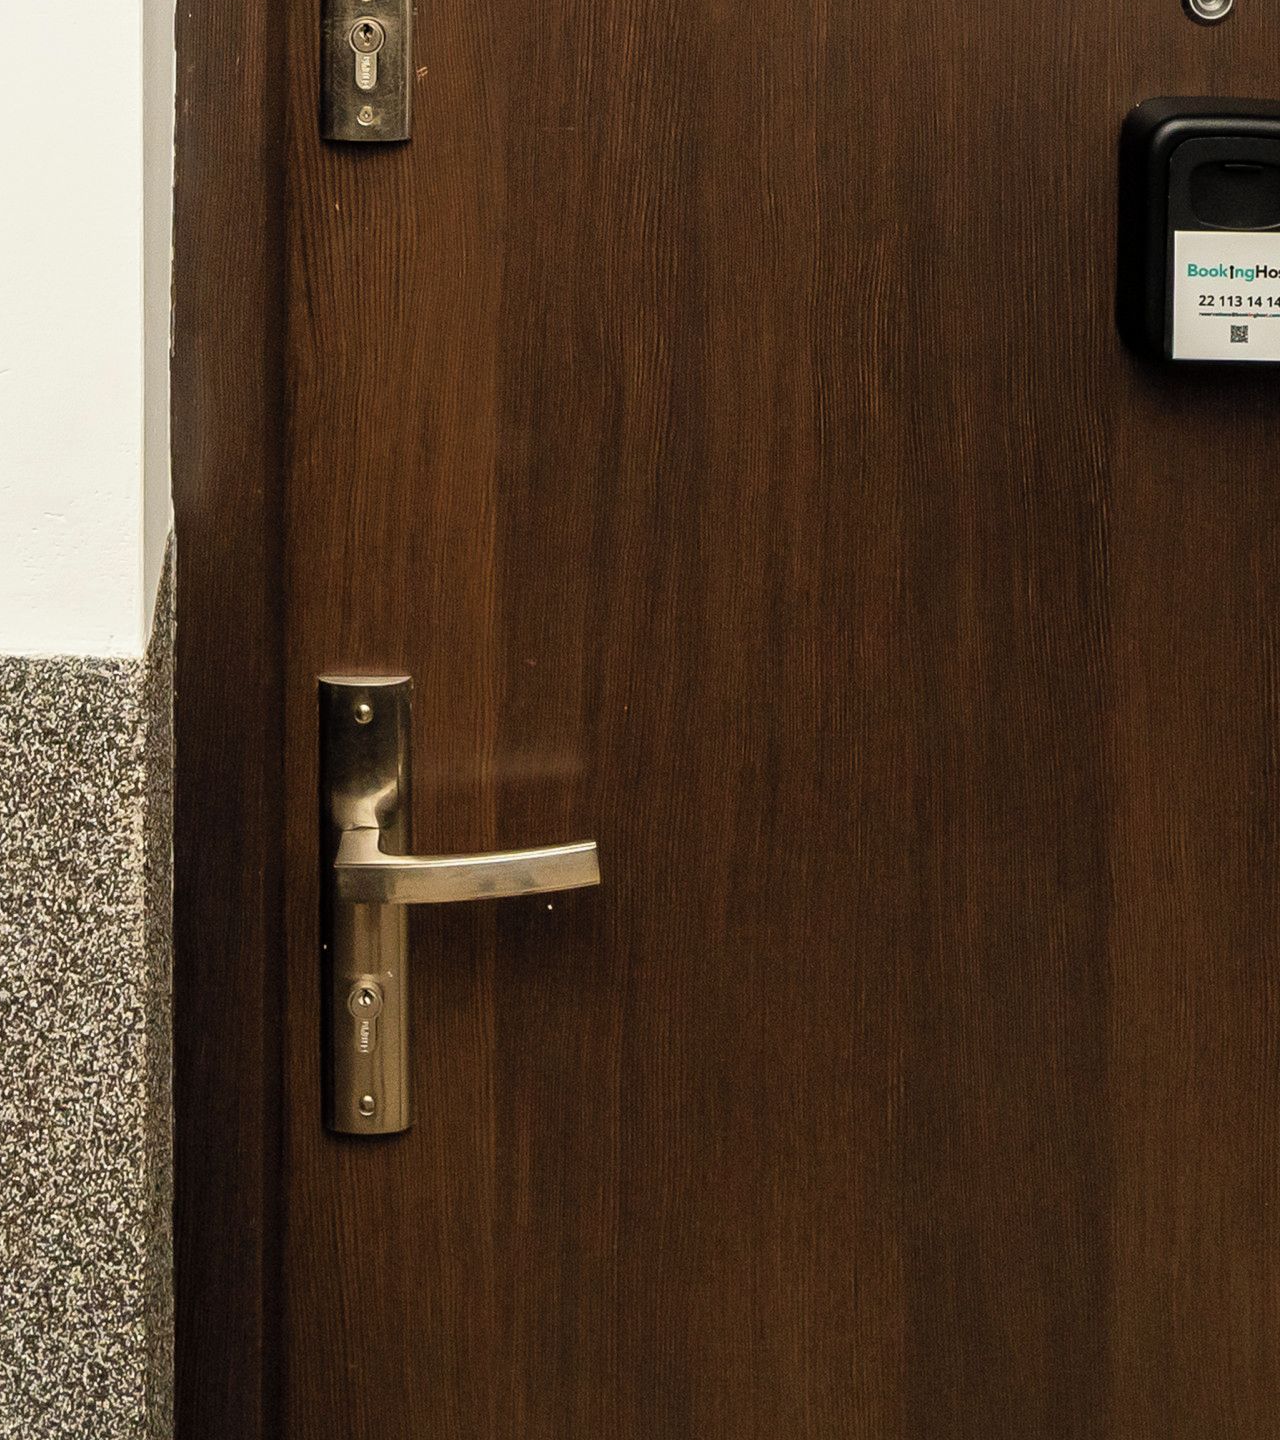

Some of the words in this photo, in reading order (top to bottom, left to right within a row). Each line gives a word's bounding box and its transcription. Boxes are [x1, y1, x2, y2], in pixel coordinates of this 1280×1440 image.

[1198, 295, 1215, 306] 22
[1219, 295, 1242, 307] 113
[1248, 296, 1263, 307] 14
